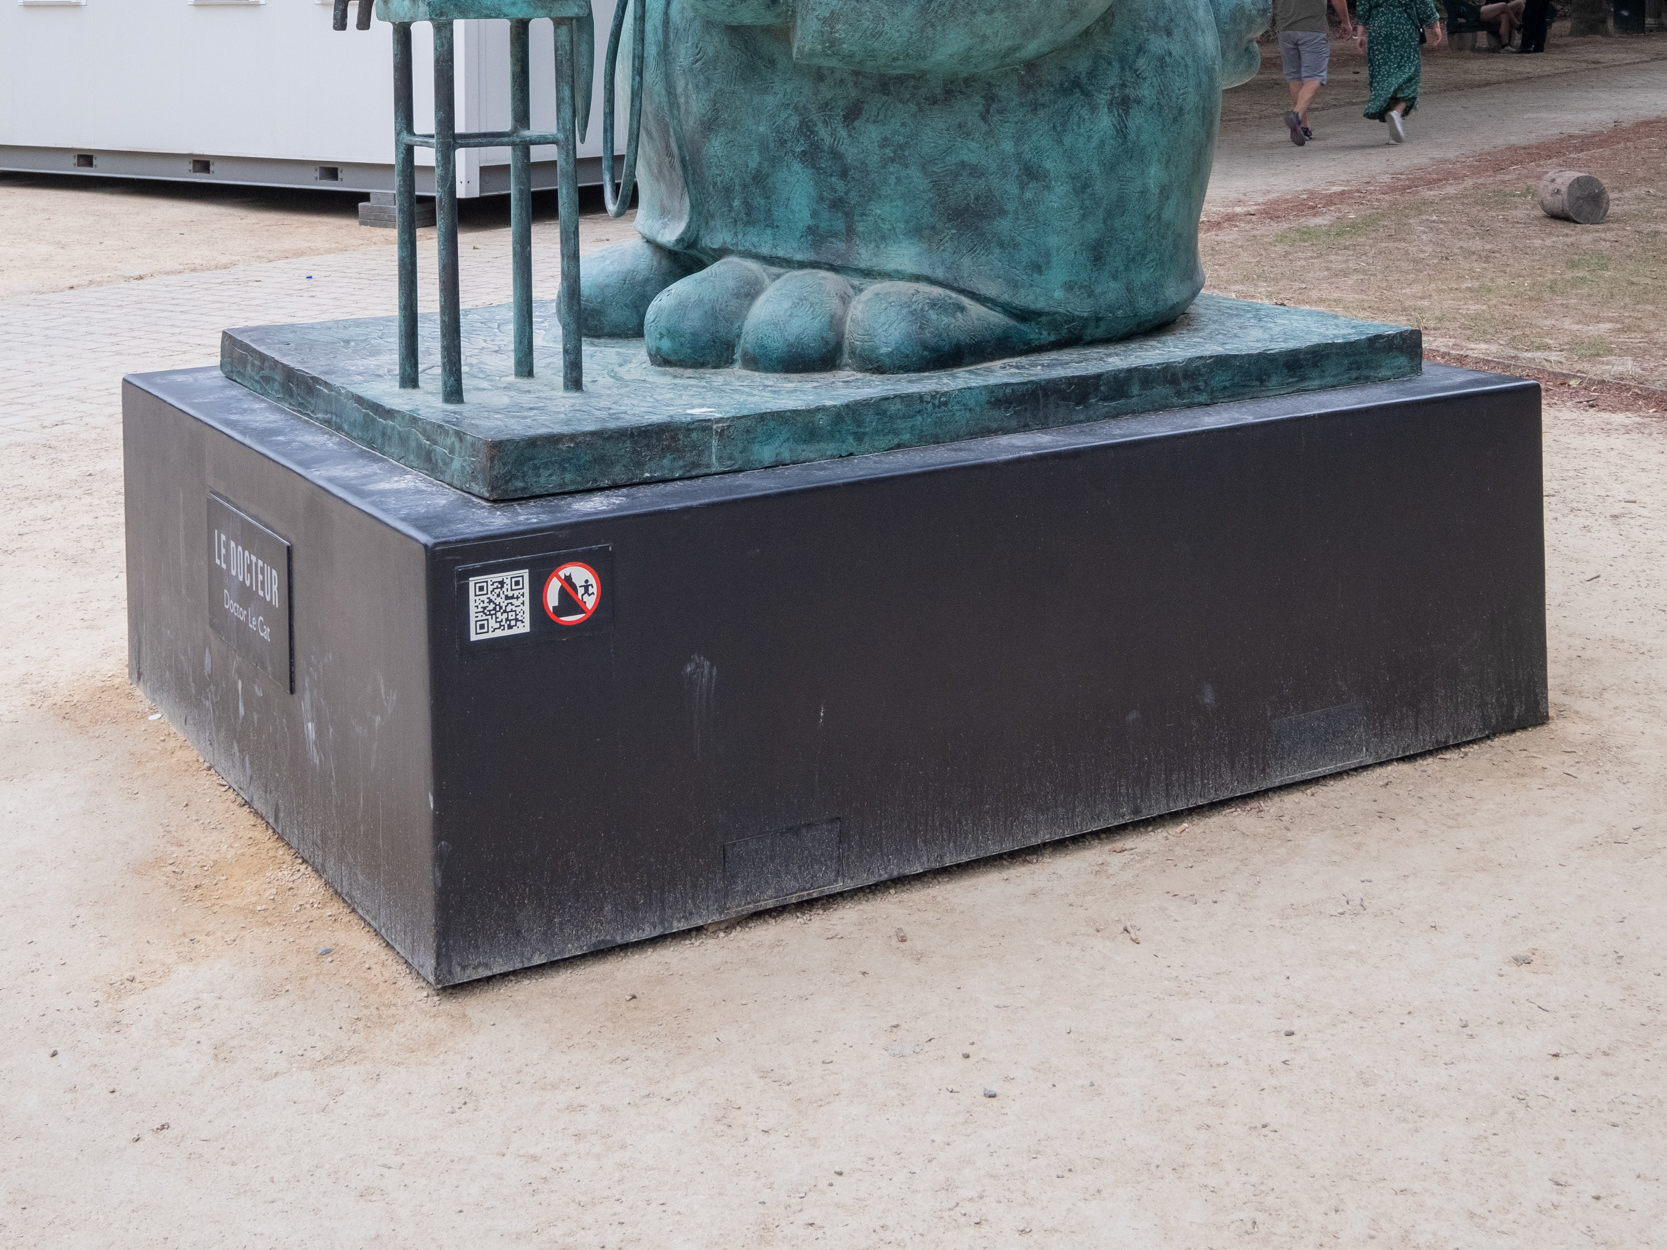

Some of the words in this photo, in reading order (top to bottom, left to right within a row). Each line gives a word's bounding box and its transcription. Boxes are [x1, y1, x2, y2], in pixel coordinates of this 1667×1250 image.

[214, 529, 227, 570] LE
[230, 540, 279, 608] DOCTEUR
[223, 589, 247, 622] Doctor
[248, 608, 257, 631] Le
[258, 616, 271, 642] Cat
